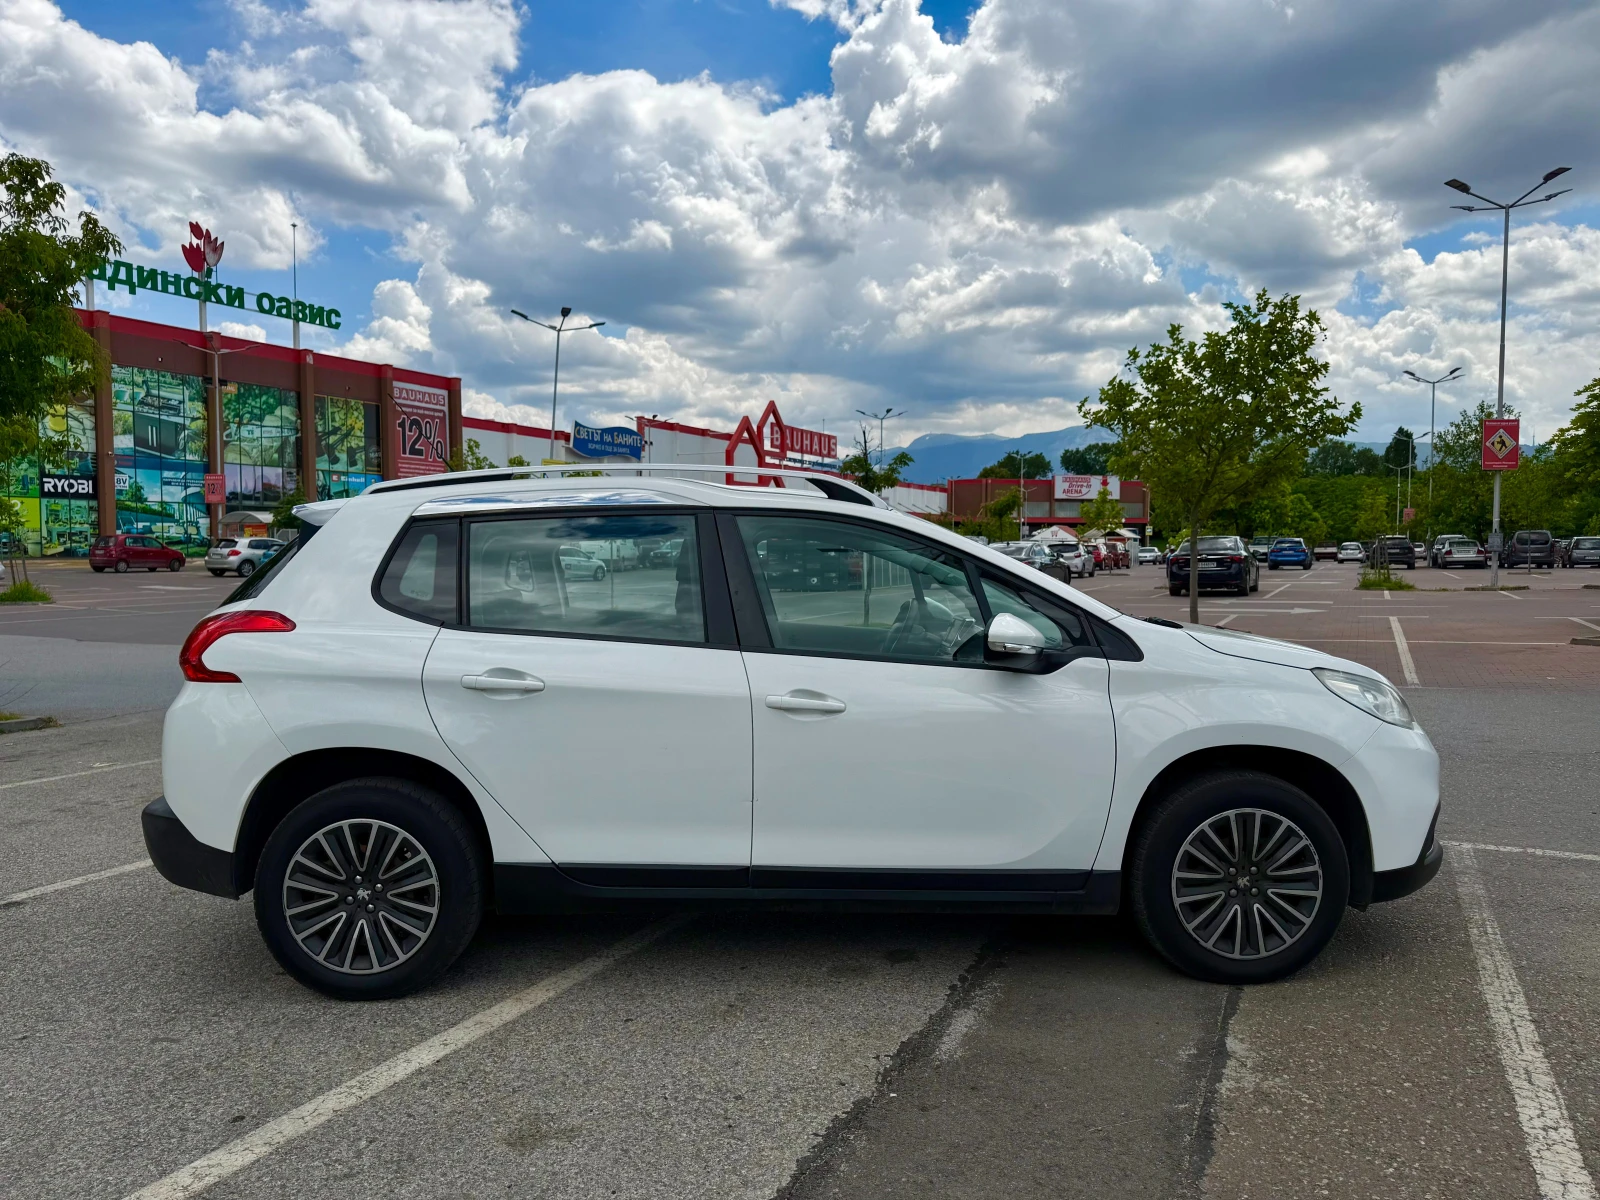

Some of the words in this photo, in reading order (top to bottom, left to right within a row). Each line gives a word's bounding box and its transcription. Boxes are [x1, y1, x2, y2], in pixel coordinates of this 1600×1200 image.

[86, 259, 245, 310] адински
[256, 292, 341, 329] оазис
[394, 387, 444, 404] BAUHAUS
[397, 415, 444, 461] 12%
[575, 426, 602, 441] СВЕТЪТ
[603, 432, 612, 443] НА
[614, 432, 641, 447] БАНИТЕ
[773, 426, 837, 456] BAUHAUS
[43, 478, 93, 494] RYOBI
[116, 477, 127, 485] 8V
